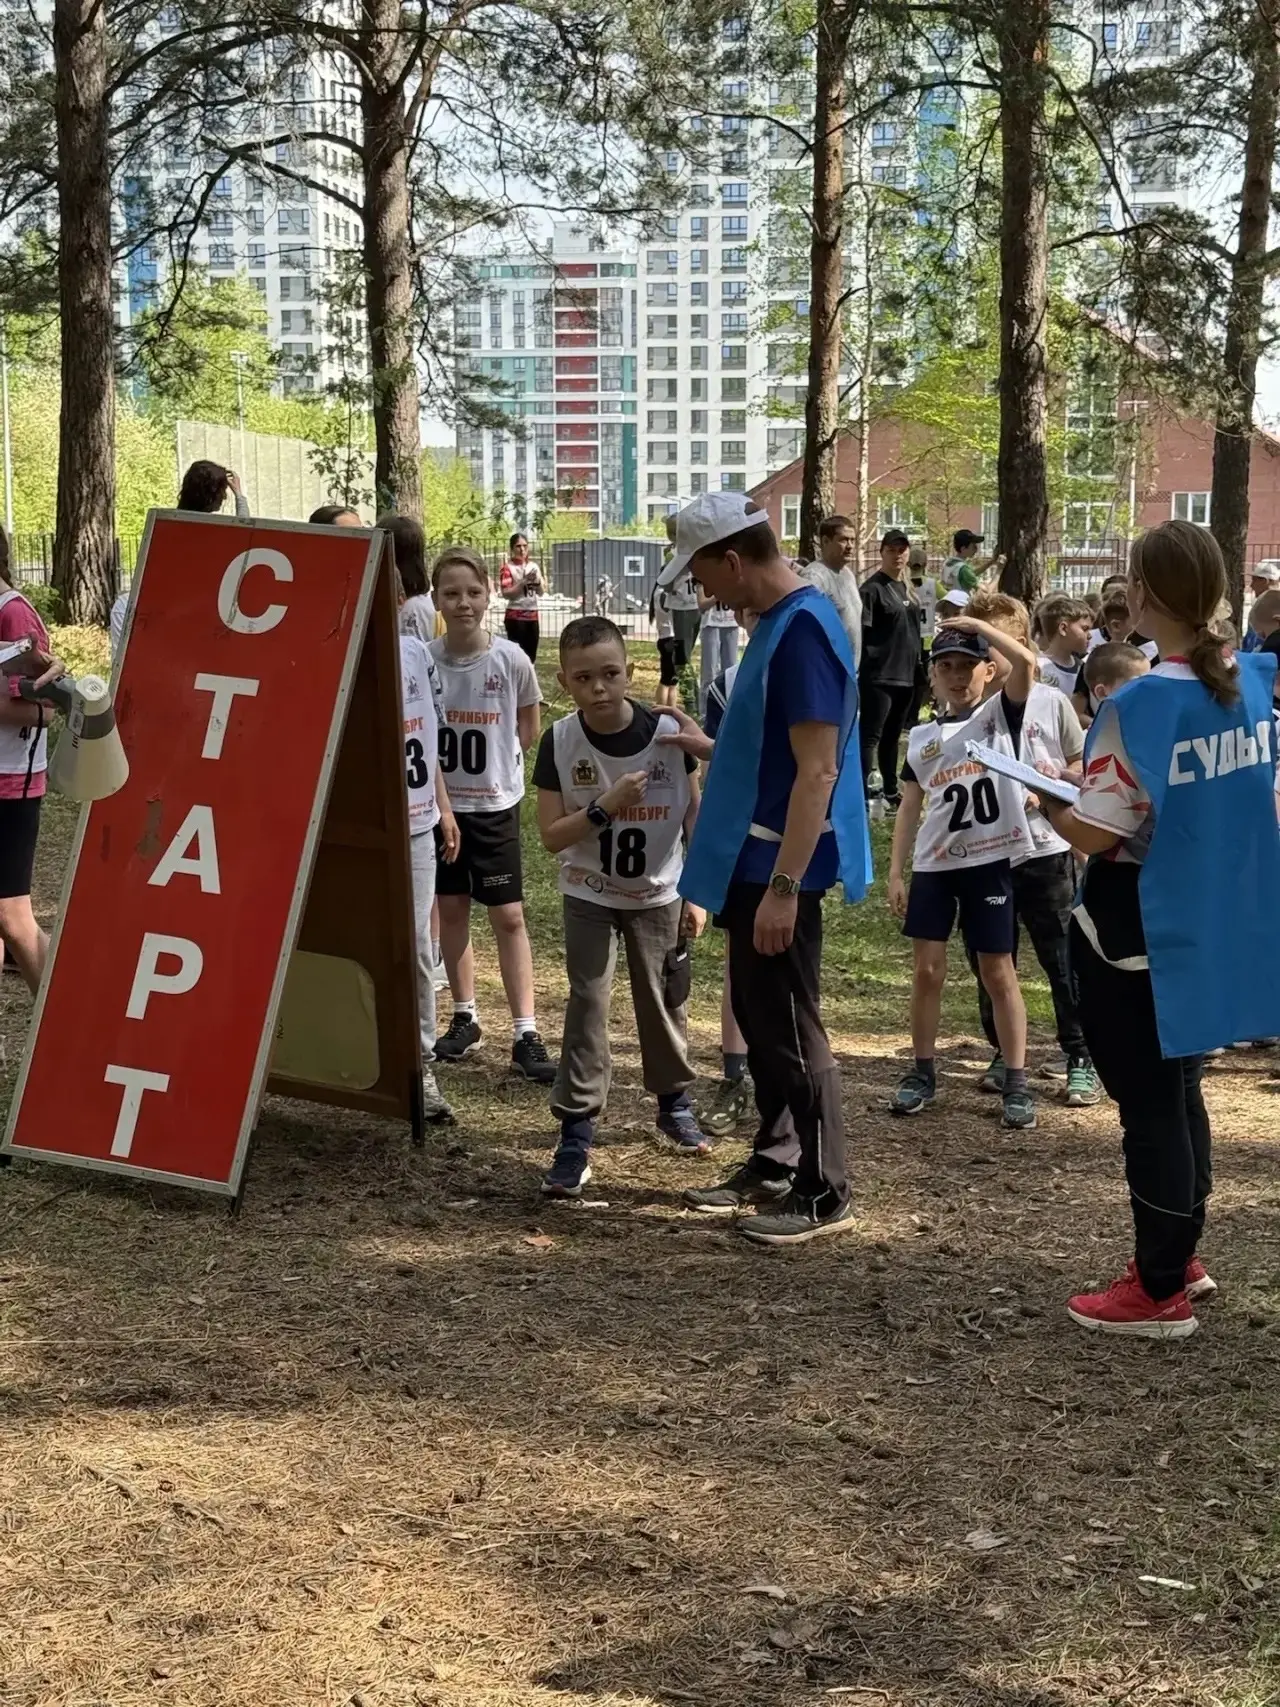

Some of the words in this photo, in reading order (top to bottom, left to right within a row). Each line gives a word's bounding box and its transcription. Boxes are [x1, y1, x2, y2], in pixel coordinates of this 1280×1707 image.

[447, 710, 502, 725] ЕРИНБУРГ
[438, 727, 486, 775] 90
[943, 777, 1000, 833] 20
[104, 547, 294, 1159] СТАРТ
[599, 828, 647, 878] 18
